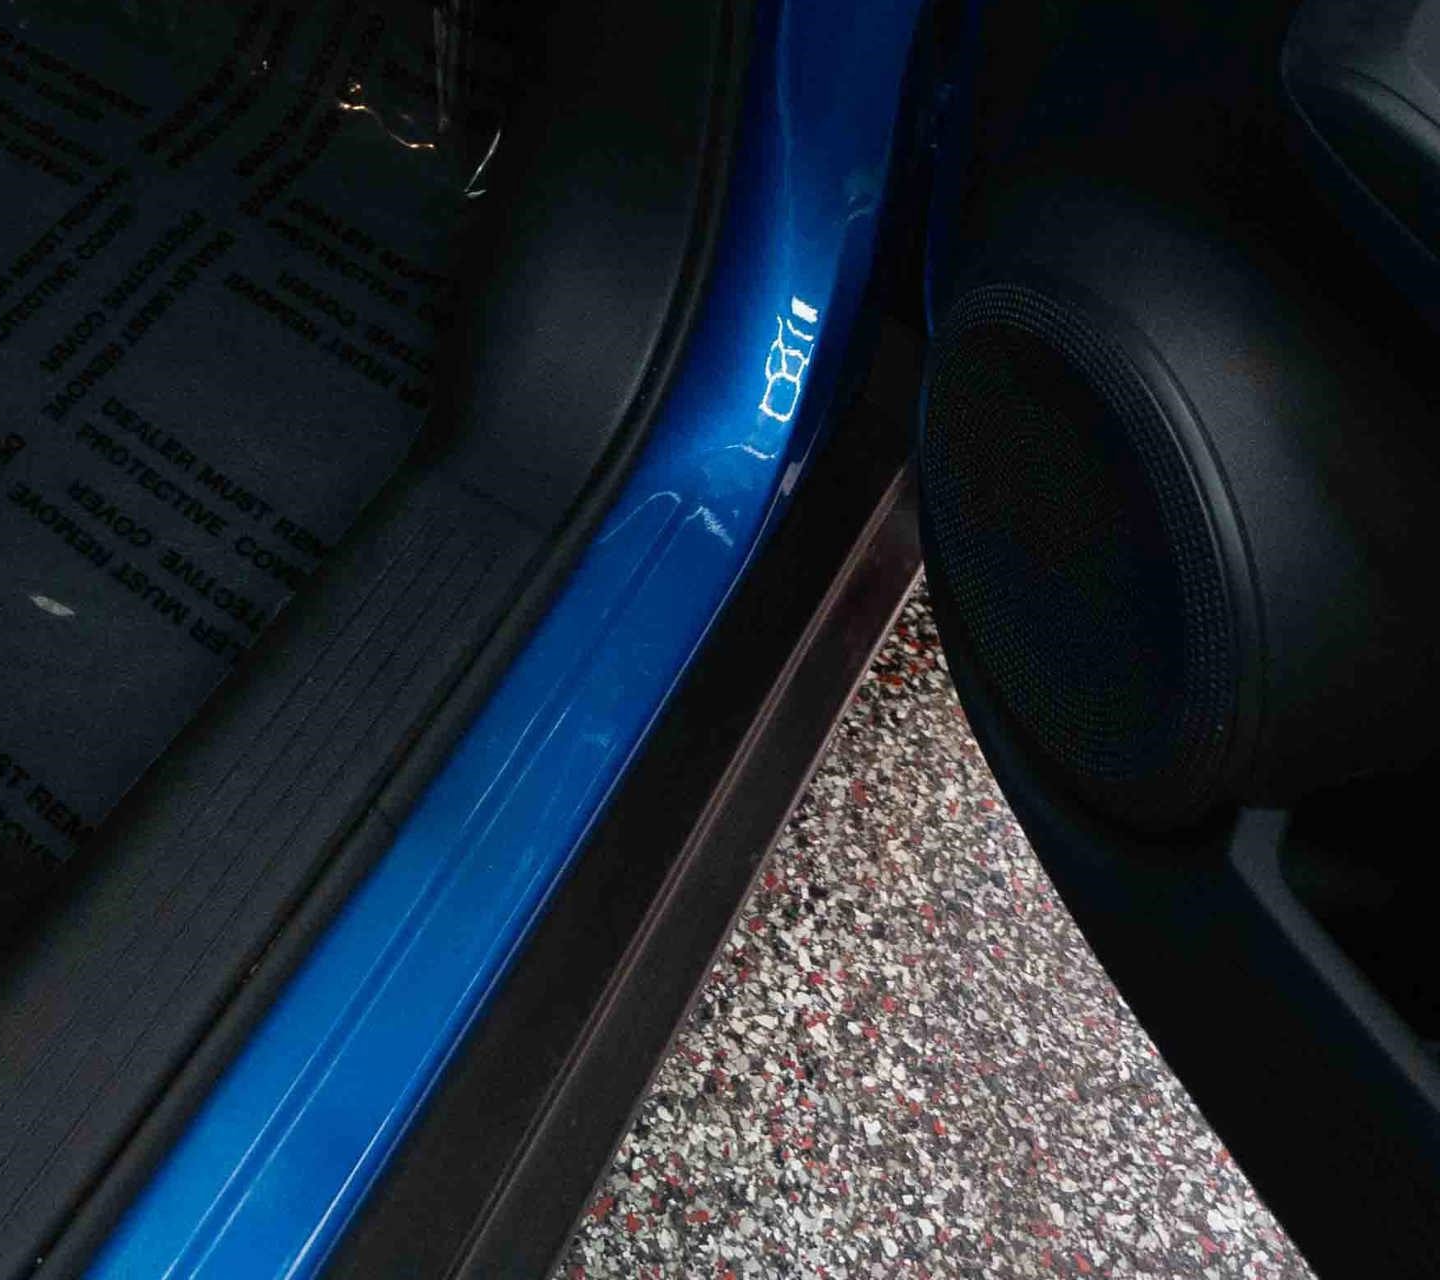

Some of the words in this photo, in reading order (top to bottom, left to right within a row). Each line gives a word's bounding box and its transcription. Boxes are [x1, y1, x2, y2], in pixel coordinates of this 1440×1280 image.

[75, 421, 227, 538] PROTECTIVE
[101, 393, 197, 470] DEALER
[197, 462, 272, 525] MUST
[4, 481, 115, 569] REMOVE
[64, 479, 153, 551] COVER
[112, 562, 189, 625] MUST
